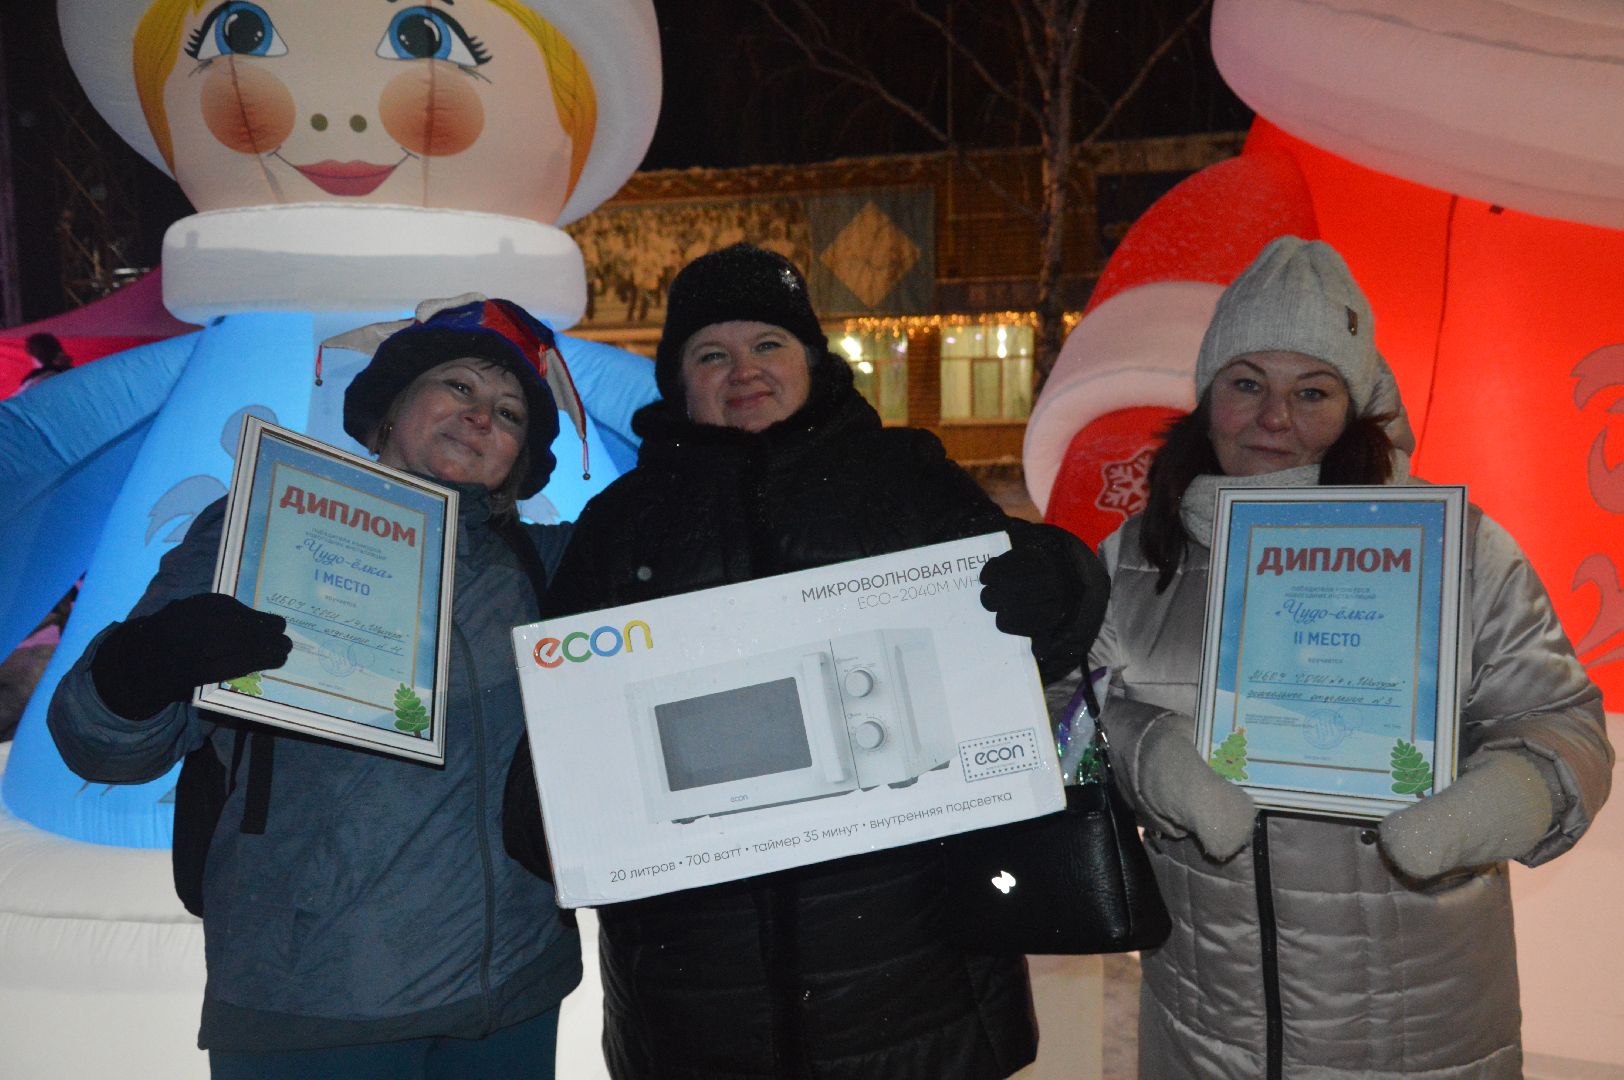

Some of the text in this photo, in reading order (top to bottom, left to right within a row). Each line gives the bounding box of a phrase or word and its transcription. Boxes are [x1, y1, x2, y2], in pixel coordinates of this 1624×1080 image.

[279, 485, 416, 547] ДИПЛОМ
[1256, 547, 1412, 576] ДИПЛОМ
[314, 569, 371, 596] I МЕСТО
[801, 561, 953, 603] МИКРОВОЛНОВАЯ
[857, 580, 950, 610] ECO-2040M
[533, 619, 653, 669] econ
[1294, 631, 1361, 648] II МЕСТО
[974, 744, 1025, 766] econ
[610, 790, 1013, 883] 20 литров 700 ватт таймер 35 минут внутренняя подсветка
